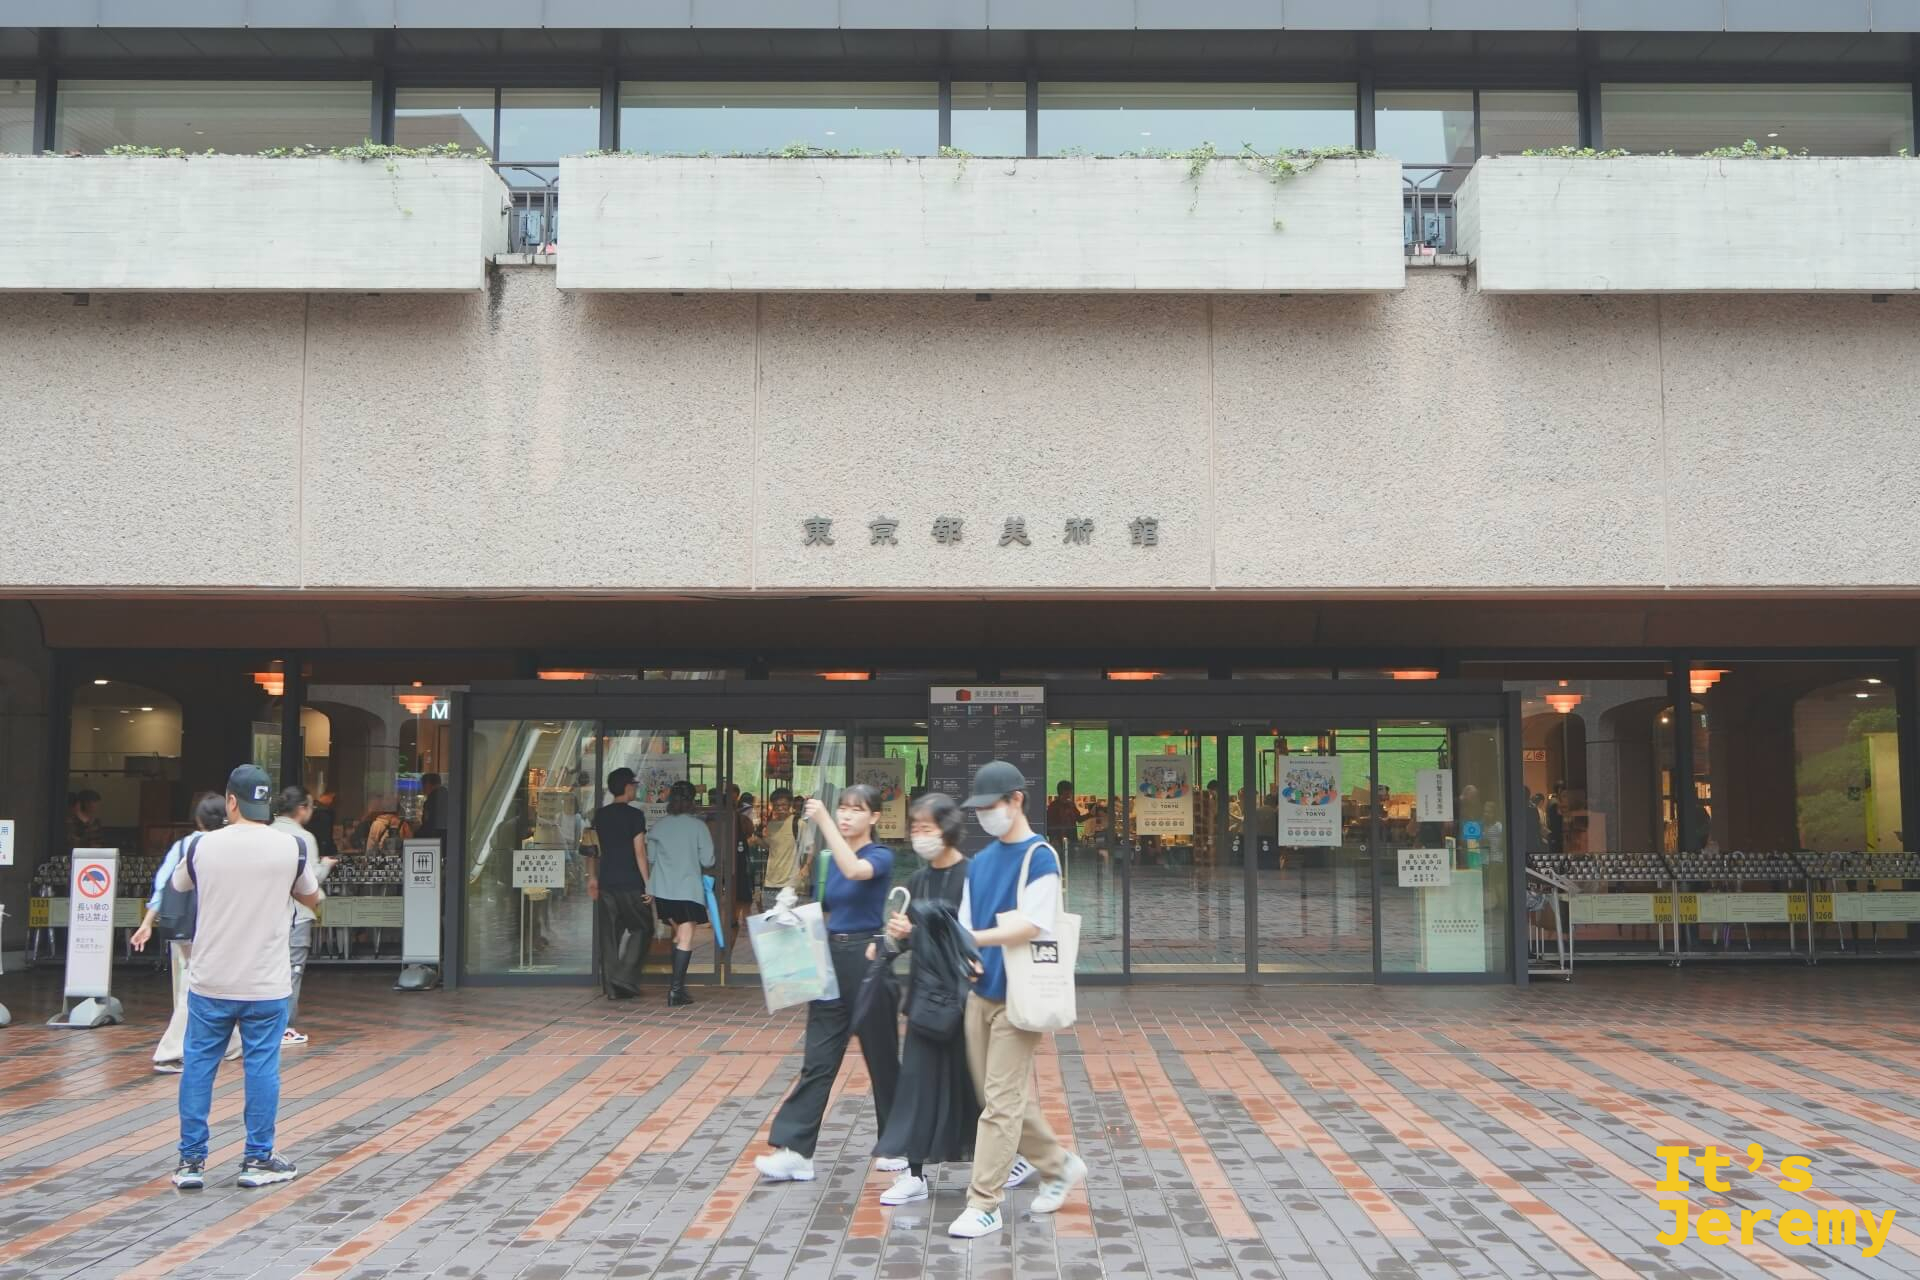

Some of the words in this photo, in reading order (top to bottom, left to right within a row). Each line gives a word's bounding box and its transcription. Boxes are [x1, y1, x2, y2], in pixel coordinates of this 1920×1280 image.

[803, 514, 1160, 547] 東京都美術館
[432, 702, 448, 719] M
[1815, 911, 1832, 920] 1260
[1031, 943, 1057, 961] Lee
